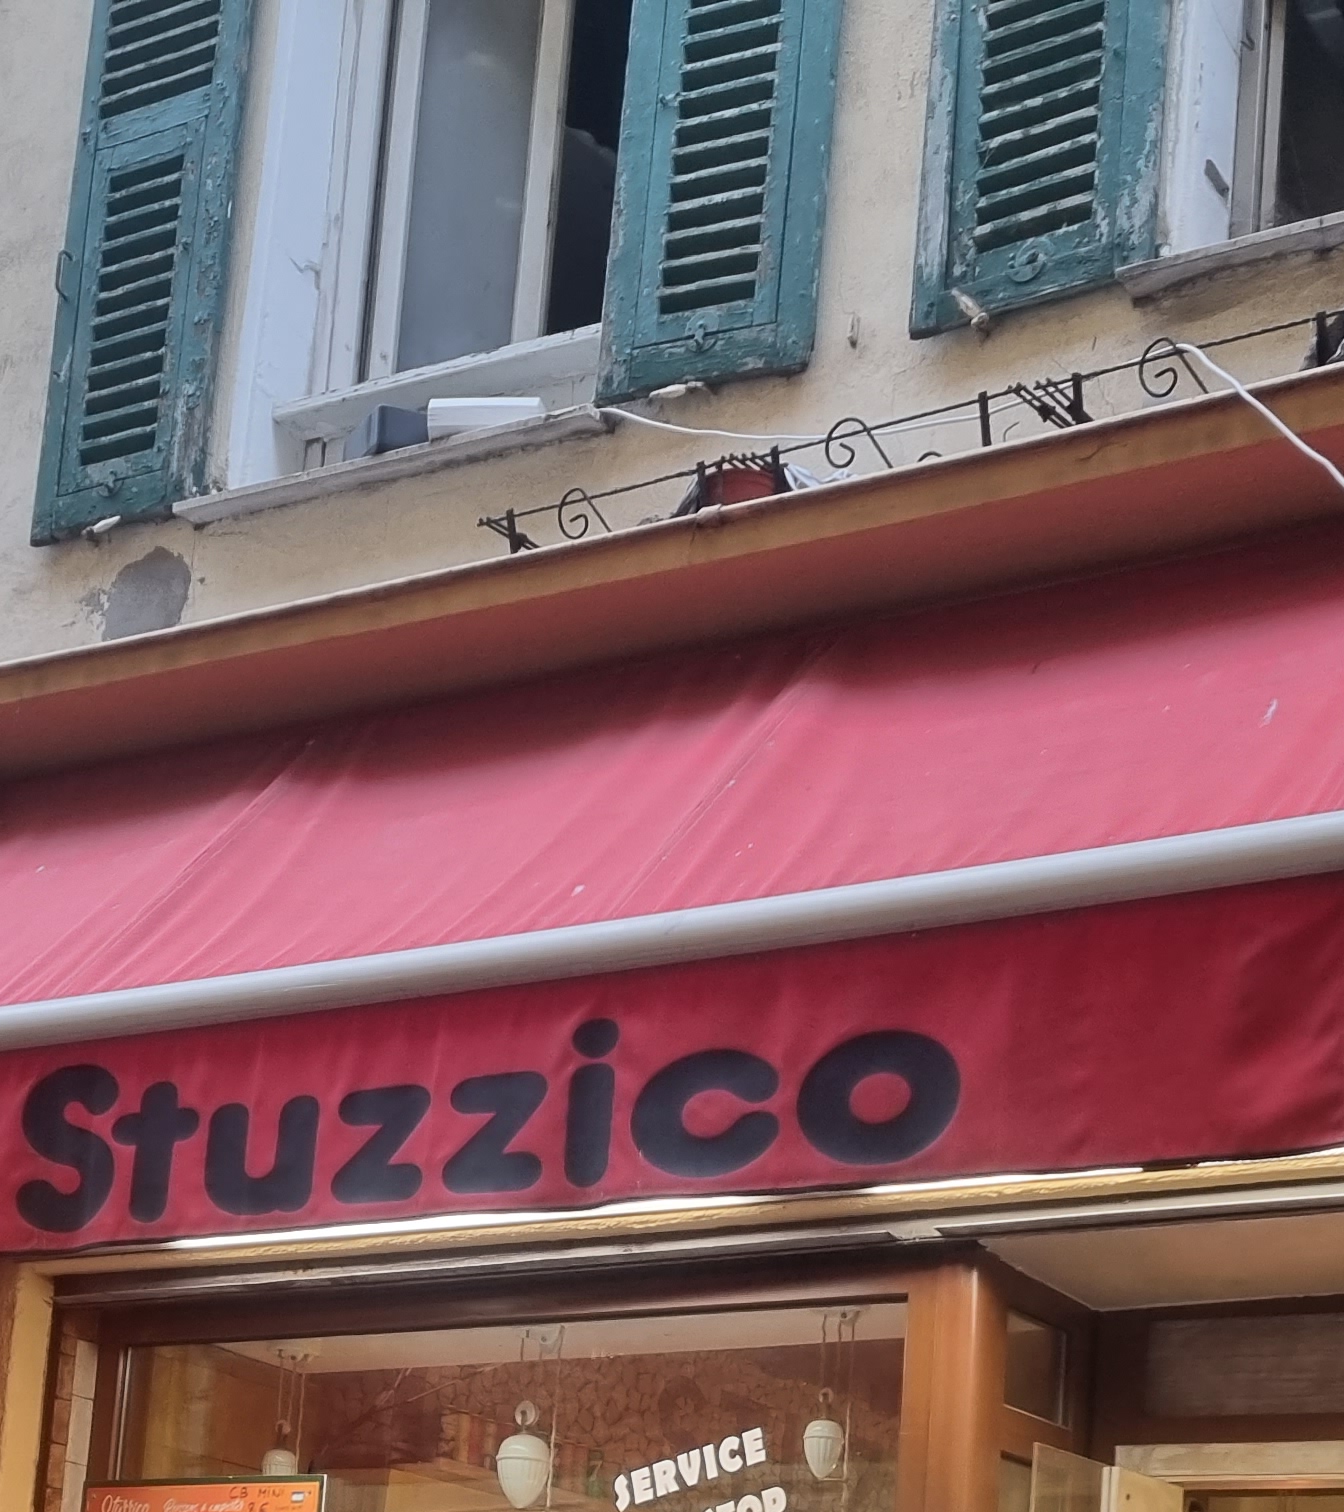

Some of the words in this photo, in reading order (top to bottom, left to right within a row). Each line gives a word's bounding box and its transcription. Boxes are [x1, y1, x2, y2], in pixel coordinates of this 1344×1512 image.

[15, 1017, 961, 1234] Stuzzico
[229, 1486, 248, 1499] CB
[614, 1427, 766, 1512] SERVICE
